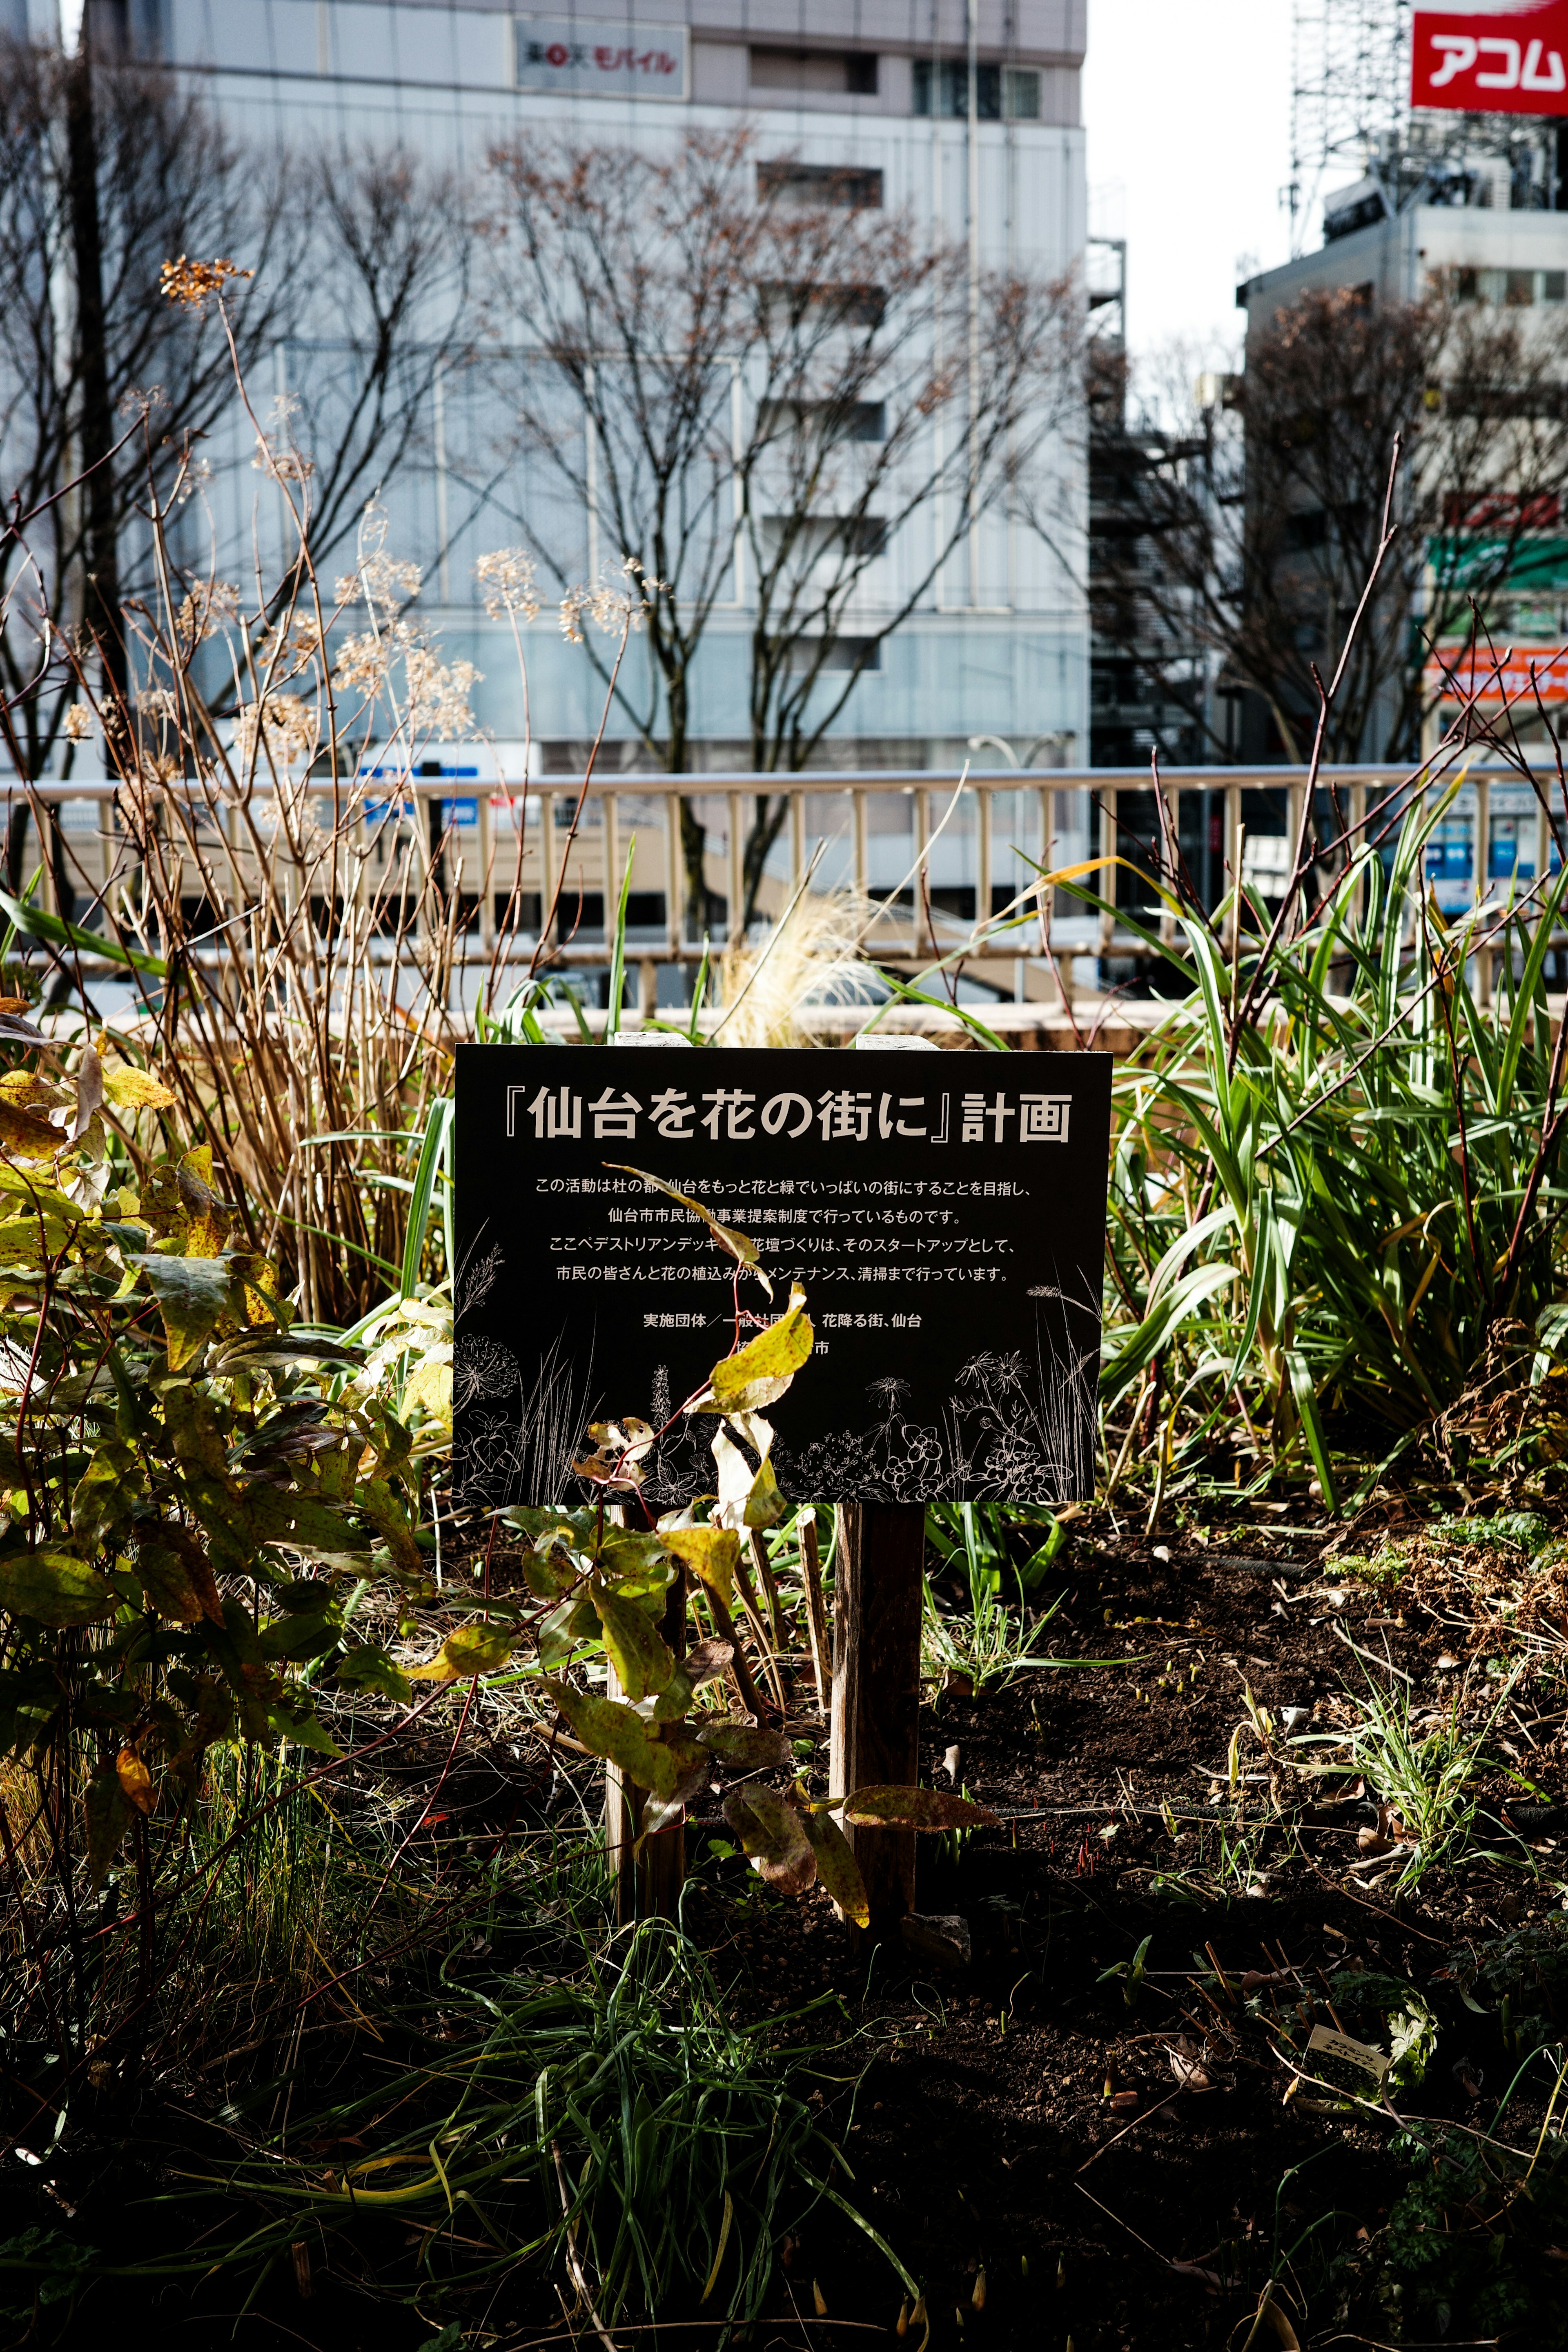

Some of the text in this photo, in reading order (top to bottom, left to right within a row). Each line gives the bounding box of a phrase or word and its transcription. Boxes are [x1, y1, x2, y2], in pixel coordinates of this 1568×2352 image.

[1429, 35, 1566, 92] アコム
[507, 1086, 1072, 1143] 『仙台を花の街に』計画
[536, 1178, 1030, 1196] この活動は杜の都仙台をもっと花と緑でいっぱいの街にすることを目指し、
[550, 1237, 1014, 1253] ここペデストリアンデッキ花壇づくりは、そのスタートアップとして、
[822, 1314, 922, 1327] 花降る街、仙台
